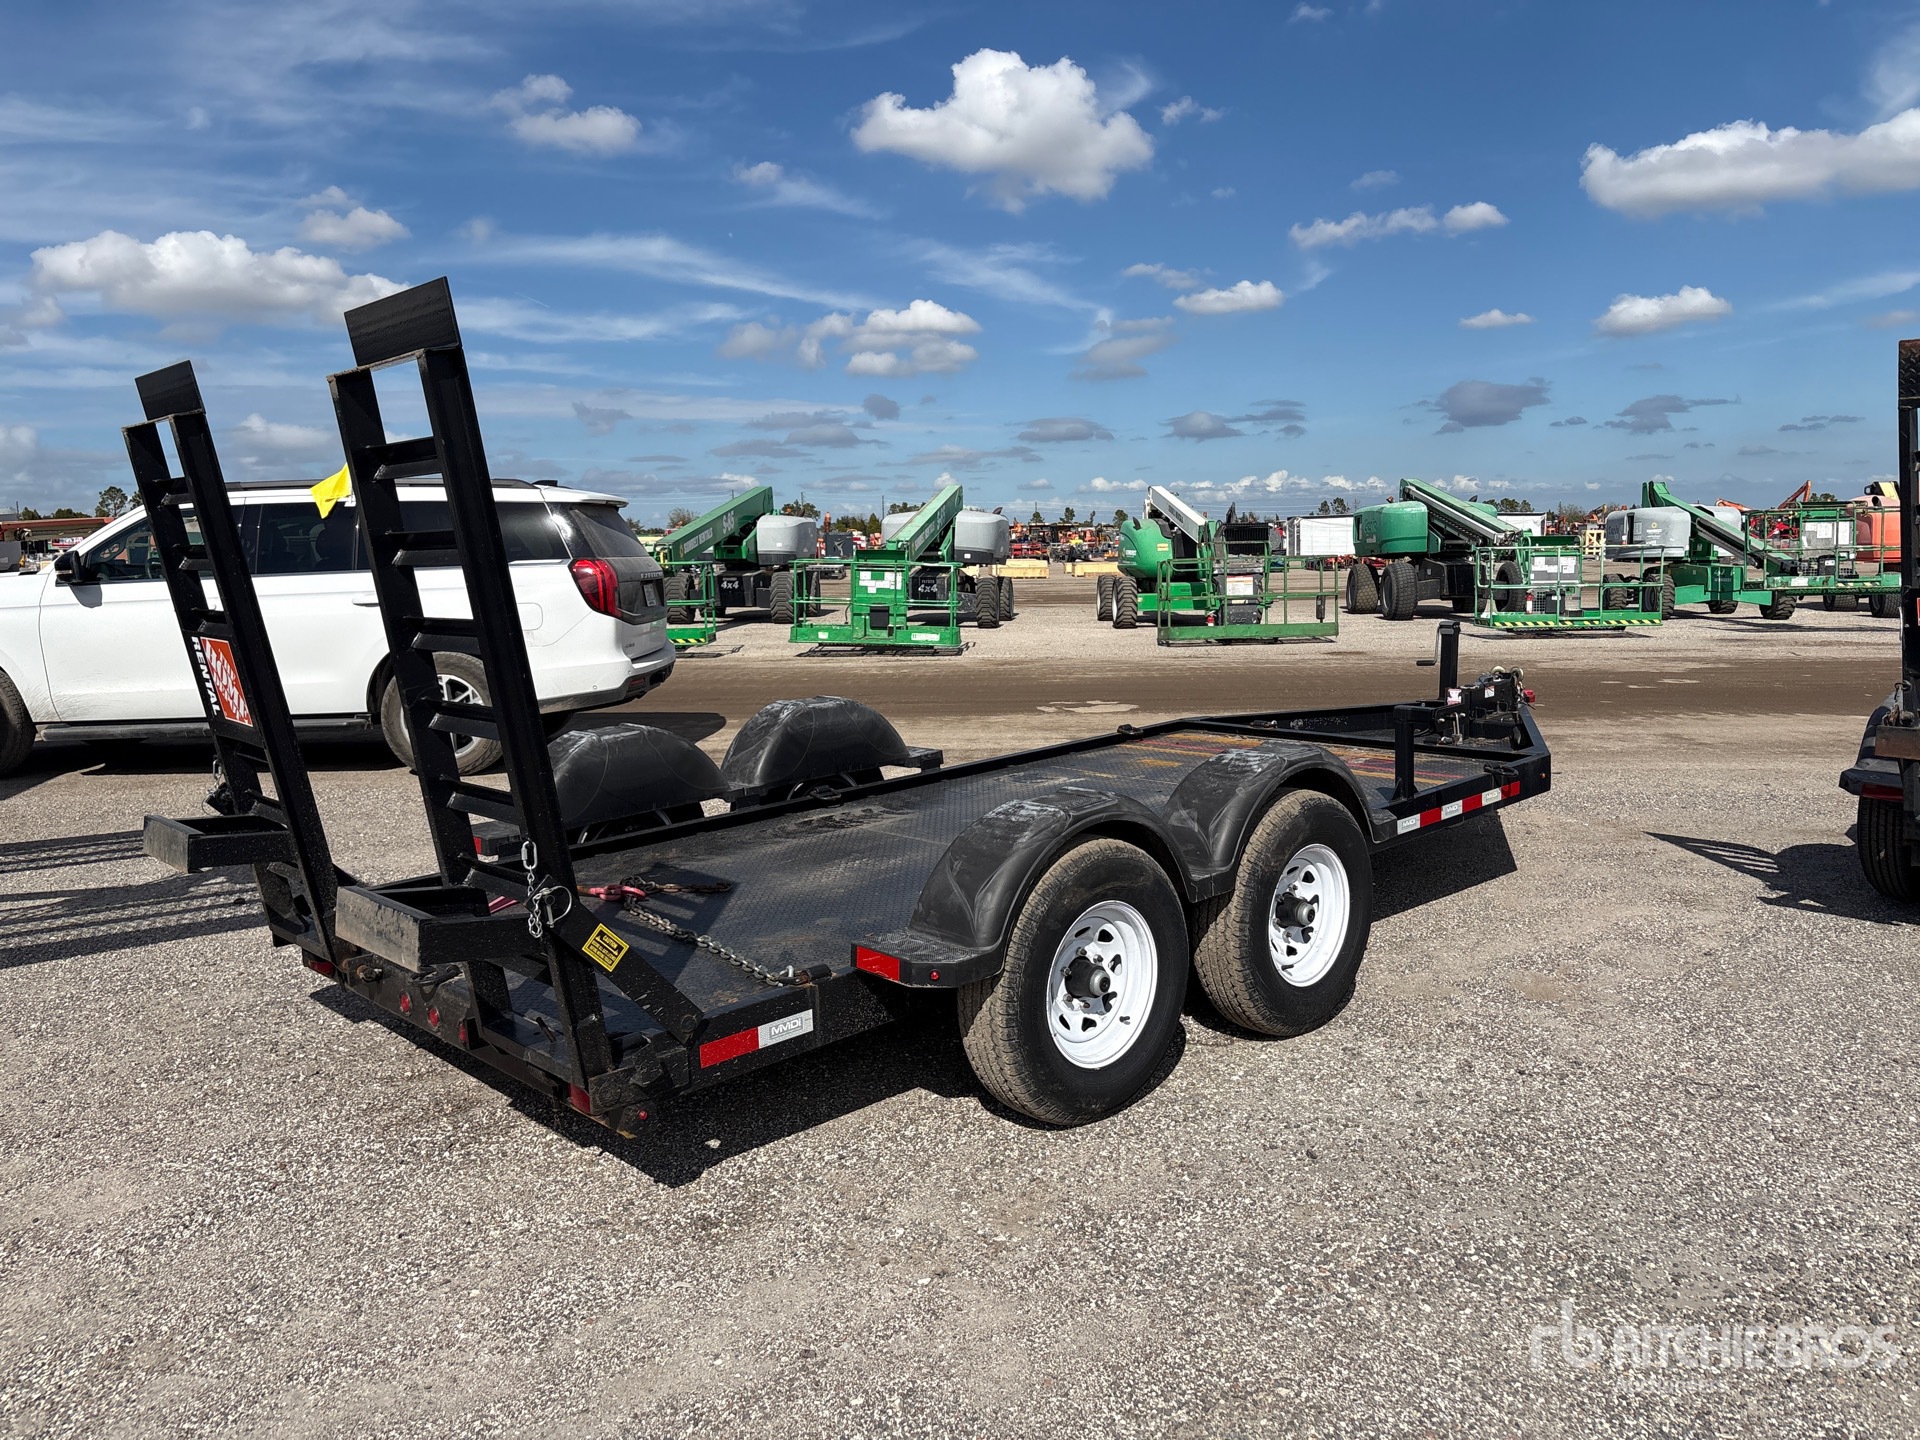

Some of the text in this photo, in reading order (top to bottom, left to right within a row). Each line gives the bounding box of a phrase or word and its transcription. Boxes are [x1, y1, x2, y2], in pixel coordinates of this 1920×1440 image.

[720, 580, 740, 590] 4x4
[917, 584, 939, 593] 4x4
[191, 636, 221, 716] RENTAL
[770, 1017, 802, 1036] MMDI
